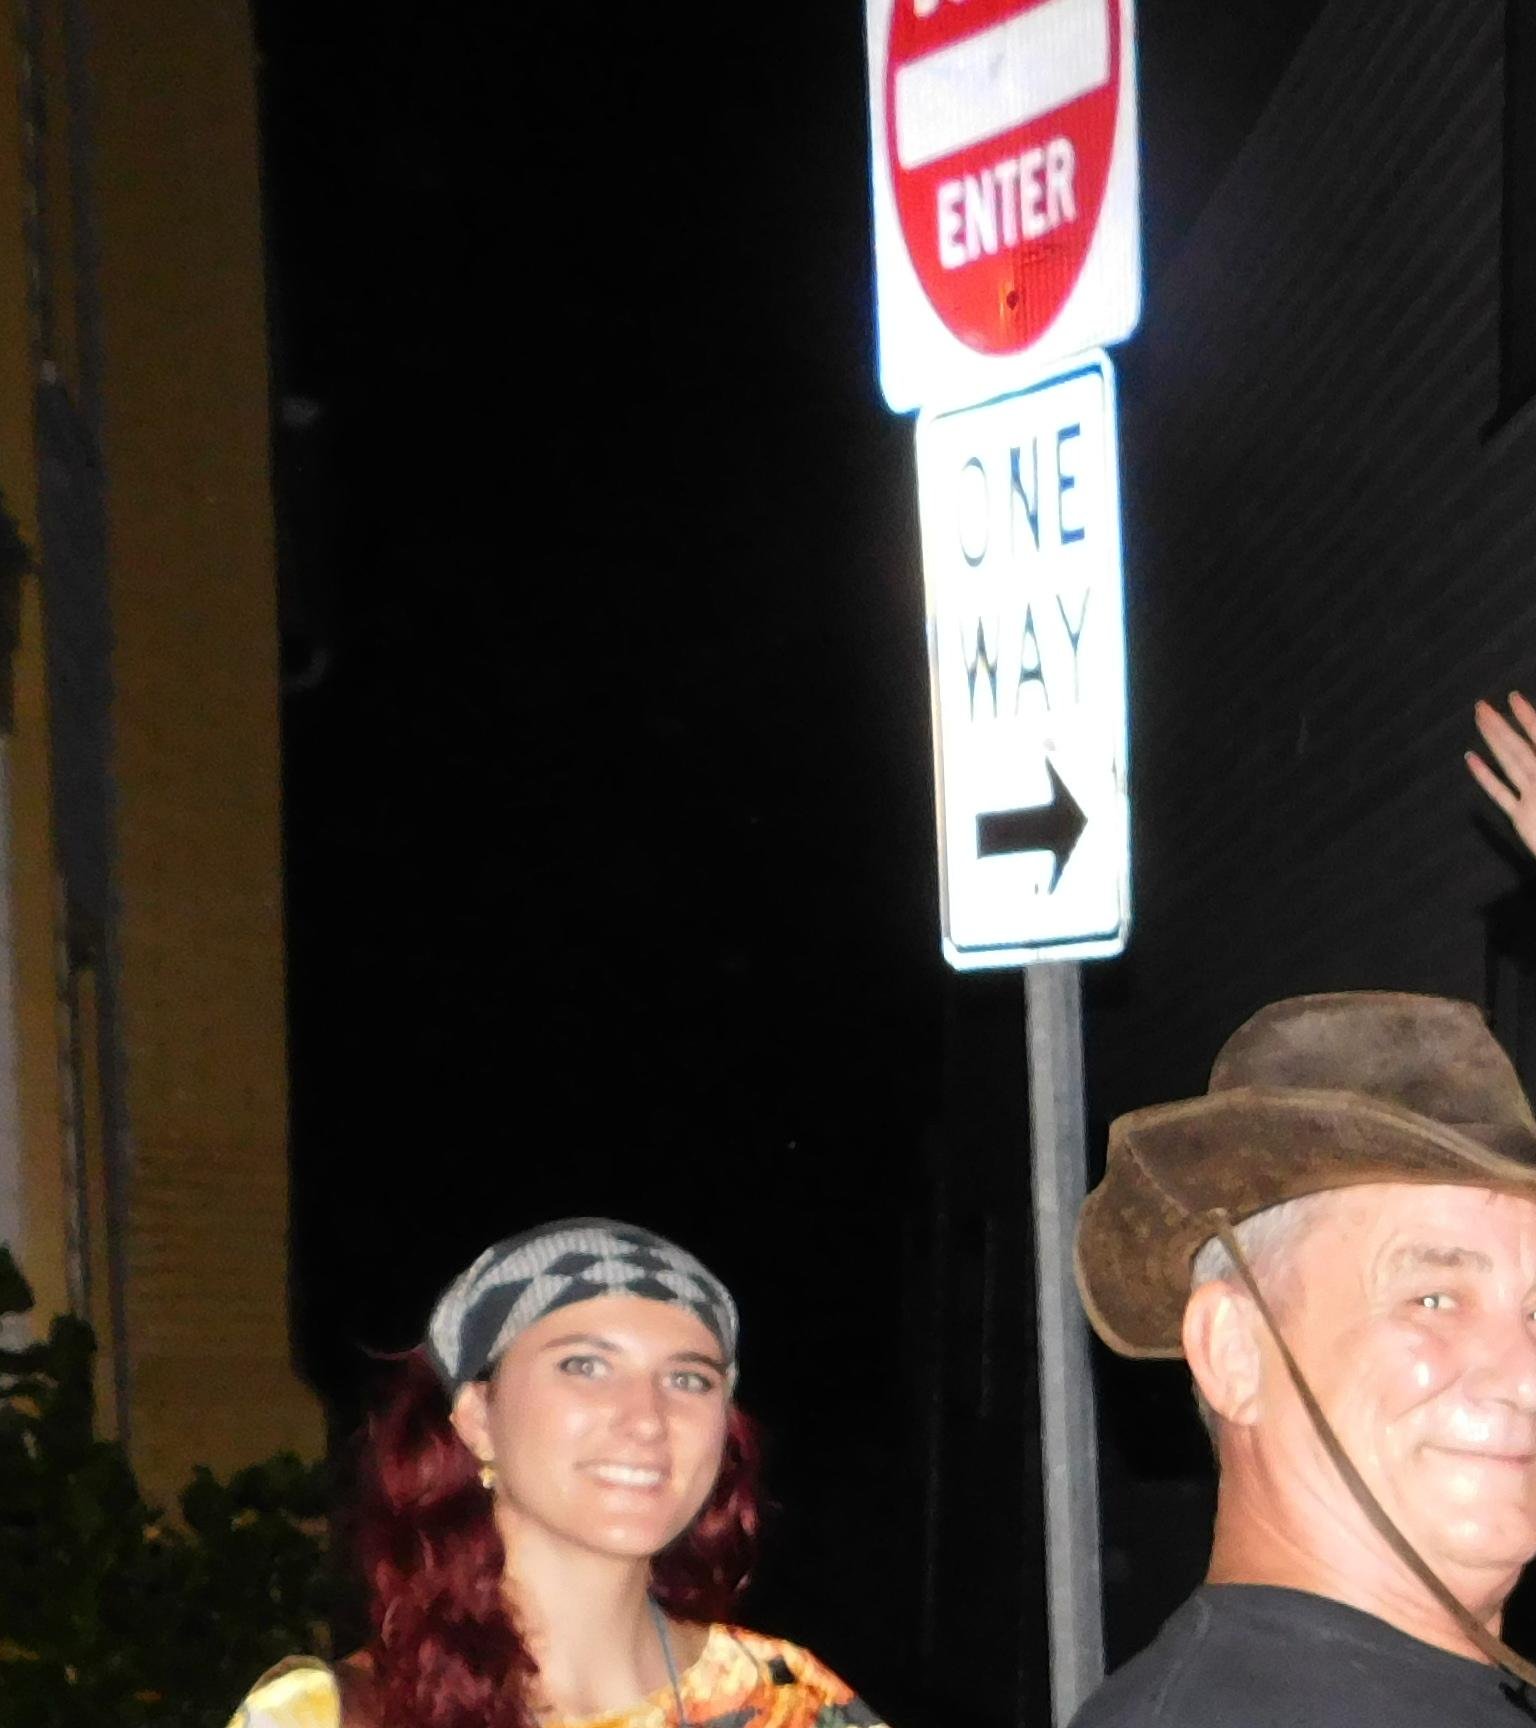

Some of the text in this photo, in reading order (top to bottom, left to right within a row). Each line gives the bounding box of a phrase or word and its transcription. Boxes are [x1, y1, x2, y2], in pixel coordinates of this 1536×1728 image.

[937, 135, 1077, 271] ENTER
[958, 422, 1086, 568] ONE
[958, 586, 1091, 722] WAY
